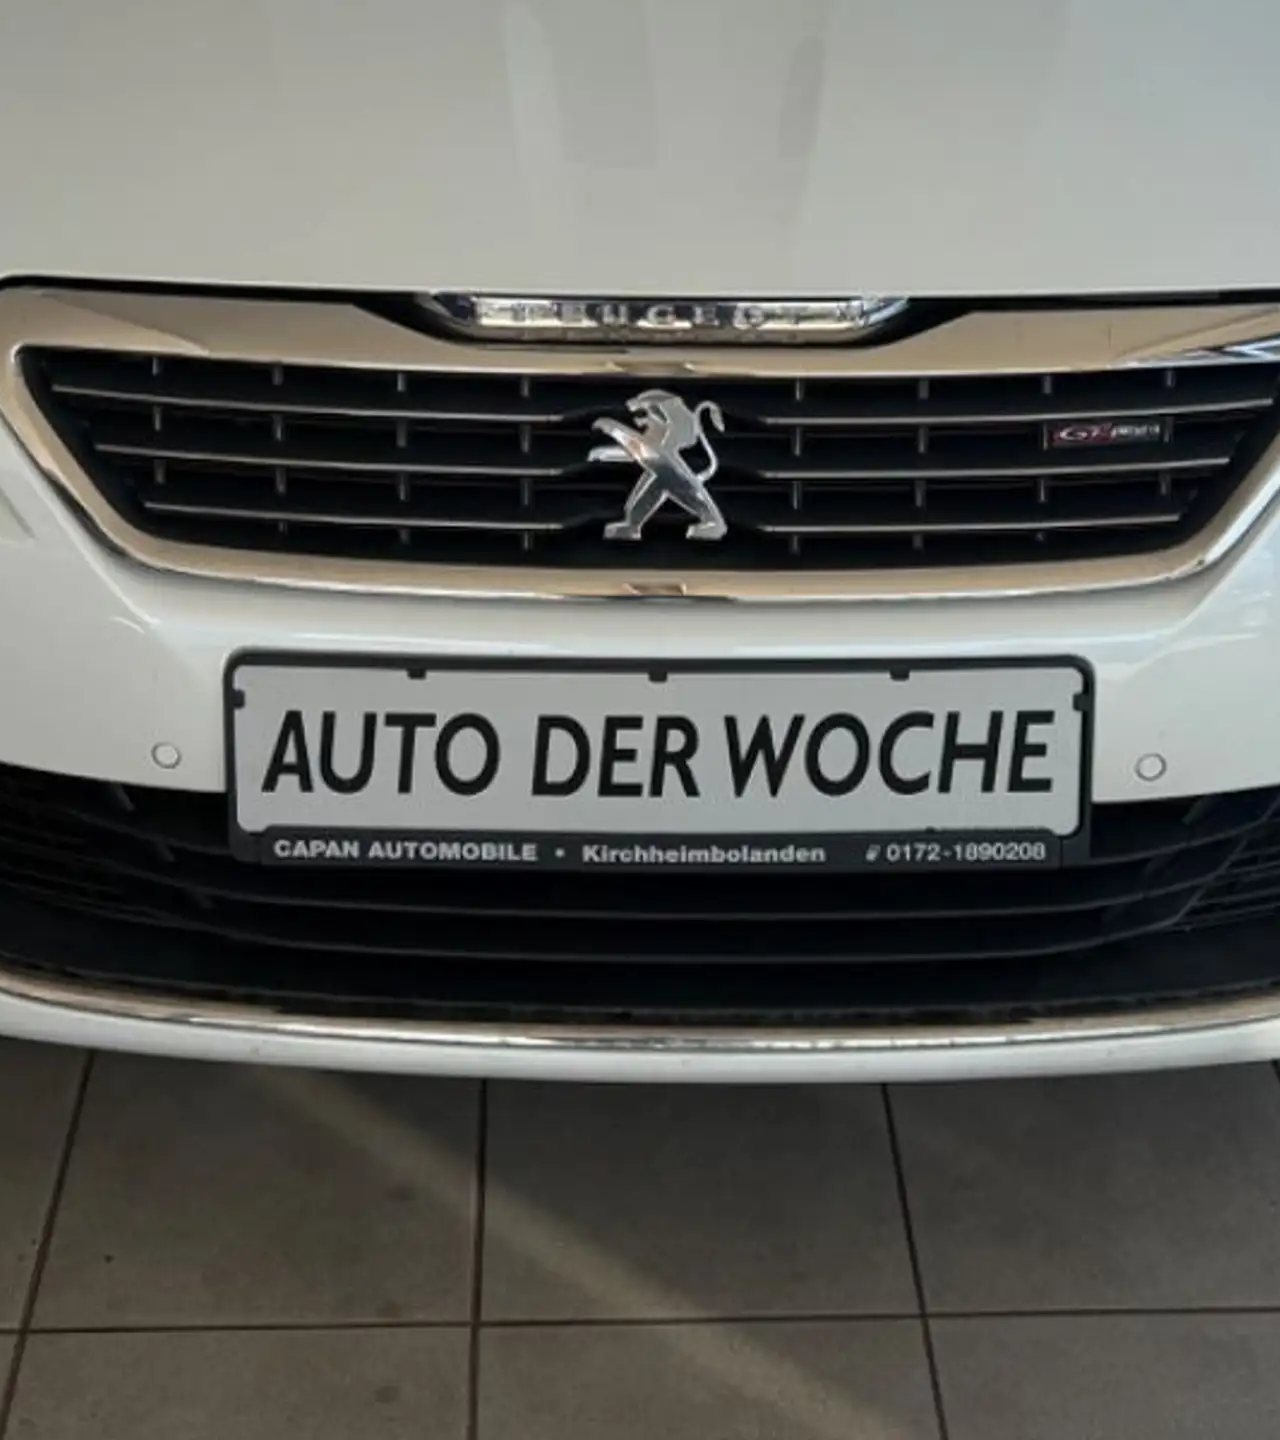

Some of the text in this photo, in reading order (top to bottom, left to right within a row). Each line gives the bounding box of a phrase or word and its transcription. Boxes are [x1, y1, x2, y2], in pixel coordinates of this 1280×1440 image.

[261, 710, 1056, 798] AUTO DER WOCHE
[273, 839, 361, 859] CAPAN
[368, 841, 538, 862] AUTOMOBILE
[582, 843, 826, 864] Kirchheimbolanden
